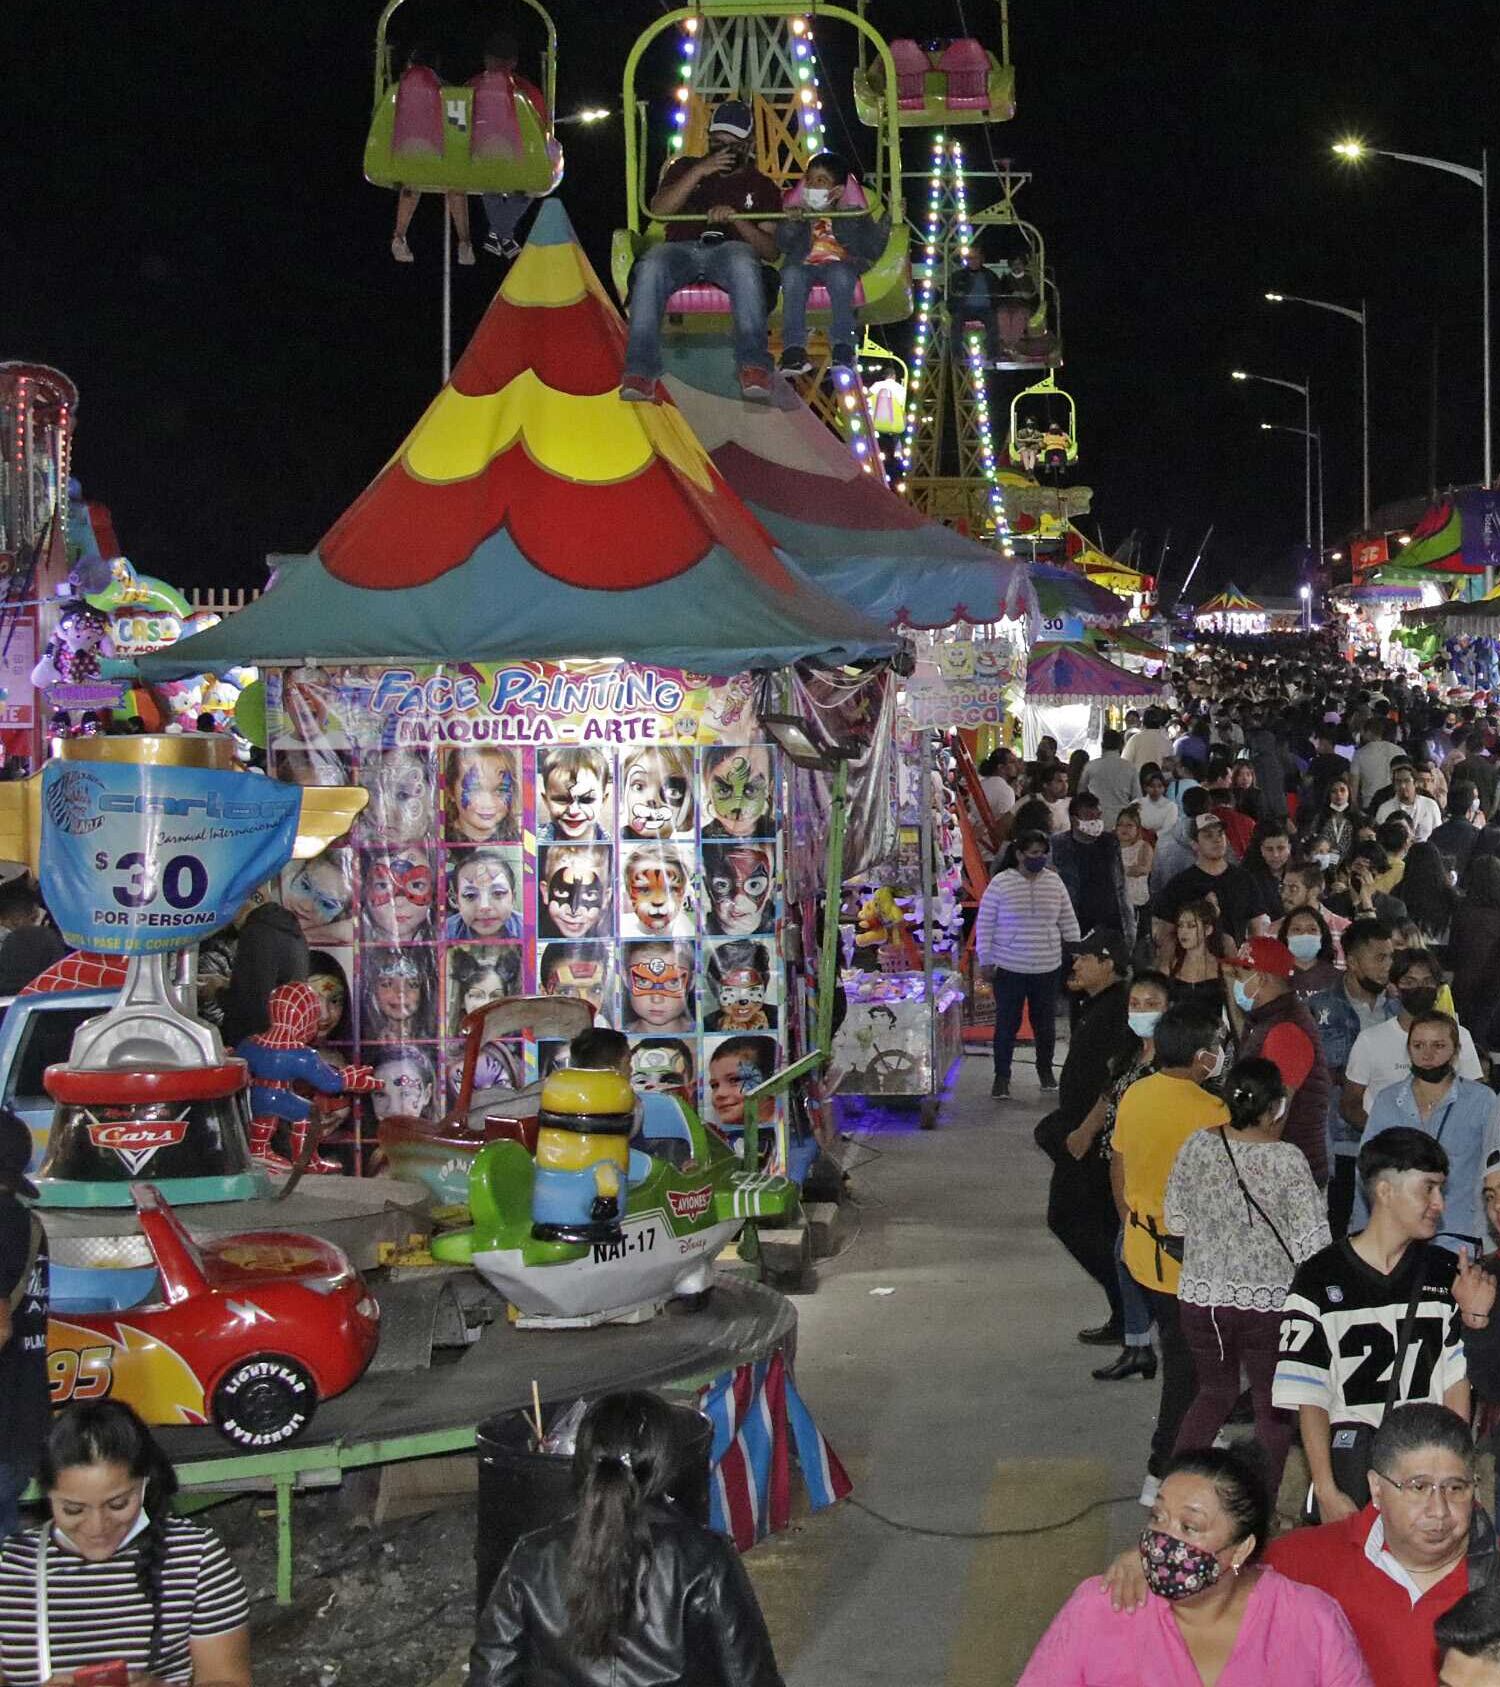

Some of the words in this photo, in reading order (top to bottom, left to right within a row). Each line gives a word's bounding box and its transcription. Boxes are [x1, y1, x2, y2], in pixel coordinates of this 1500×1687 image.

[1043, 618, 1064, 631] 30
[369, 668, 481, 715] FACE
[488, 666, 684, 715] PAINTING
[400, 717, 553, 744] MAQUILLA
[583, 716, 657, 743] ARTE
[208, 820, 284, 841] Internaciona
[95, 851, 109, 871] $
[112, 851, 209, 910] 30
[93, 910, 129, 926] POR
[135, 911, 217, 927] PERSONA
[98, 1126, 175, 1142] Cars
[678, 1194, 708, 1211] AVIONES
[1278, 1318, 1315, 1353] 27
[46, 1346, 114, 1403] 95
[1338, 1316, 1444, 1406] 27
[224, 1362, 306, 1394] LIGHTYEAR
